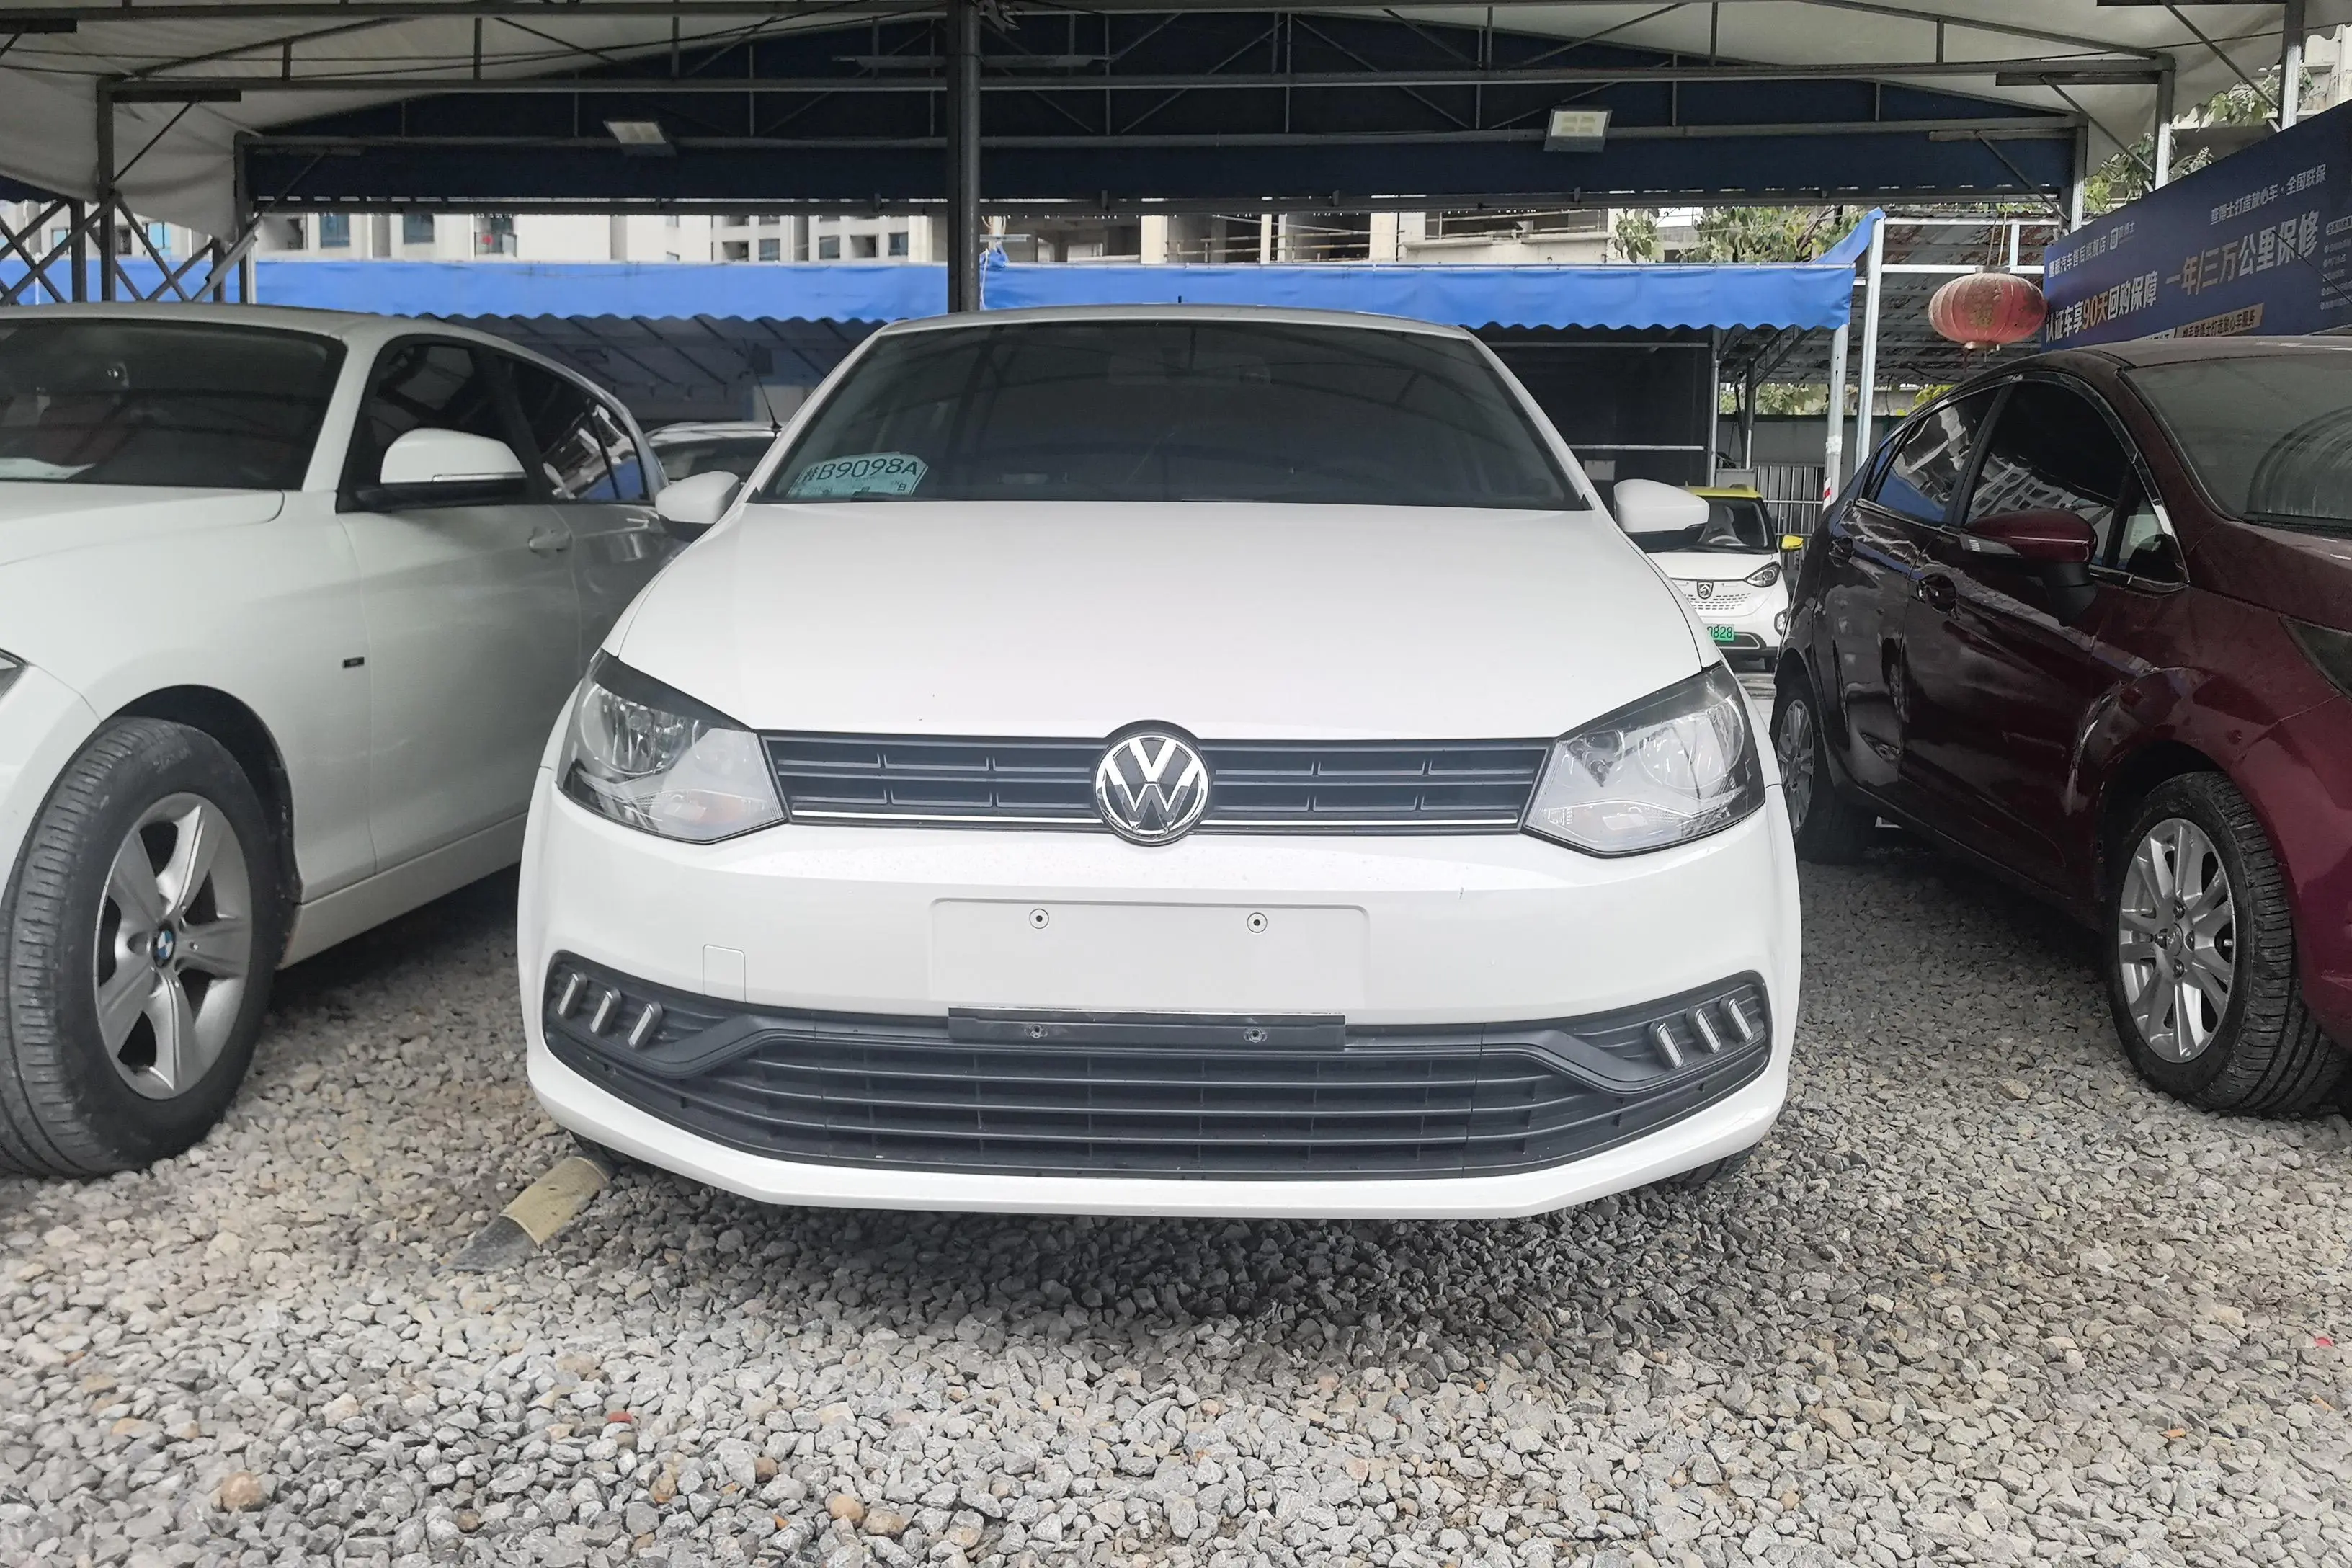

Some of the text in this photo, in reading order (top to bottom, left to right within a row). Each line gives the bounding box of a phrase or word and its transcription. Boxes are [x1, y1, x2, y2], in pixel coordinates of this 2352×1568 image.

[2046, 271, 2158, 344] 认证车享90天回购保障
